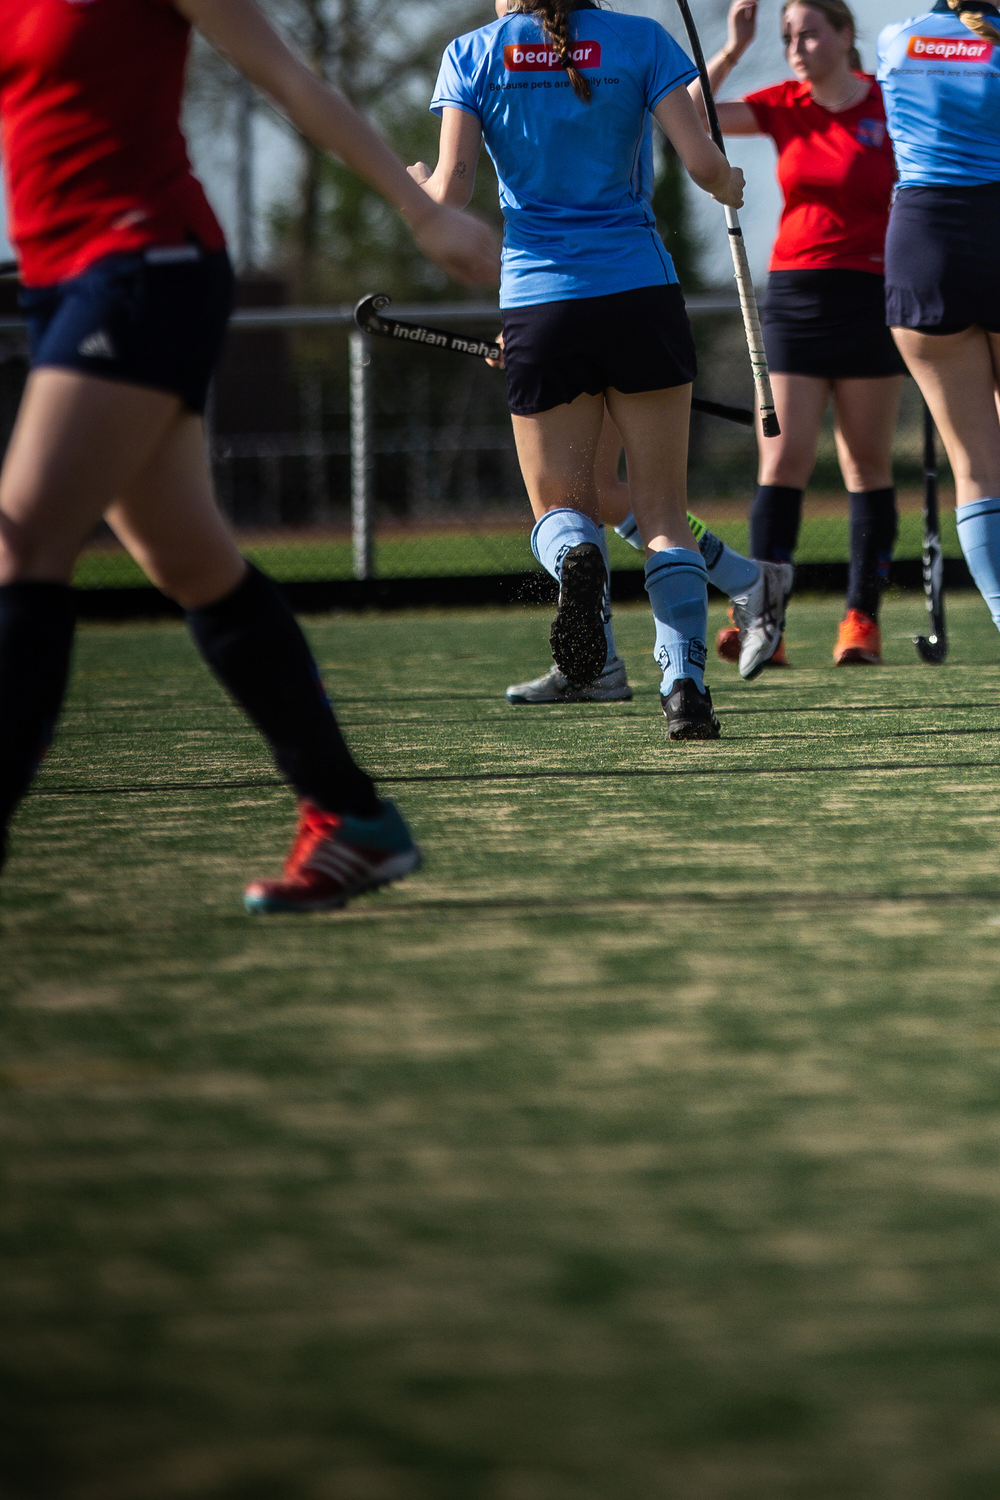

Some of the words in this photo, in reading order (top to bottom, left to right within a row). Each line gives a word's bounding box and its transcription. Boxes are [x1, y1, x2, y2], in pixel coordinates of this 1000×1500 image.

[512, 48, 592, 66] beapar
[913, 39, 987, 58] beaphar
[926, 68, 945, 77] pets
[947, 69, 961, 77] are
[963, 69, 988, 79] family
[489, 81, 529, 92] Because
[531, 80, 552, 91] pets
[554, 80, 570, 89] are
[603, 76, 620, 85] too
[393, 324, 448, 347] indian
